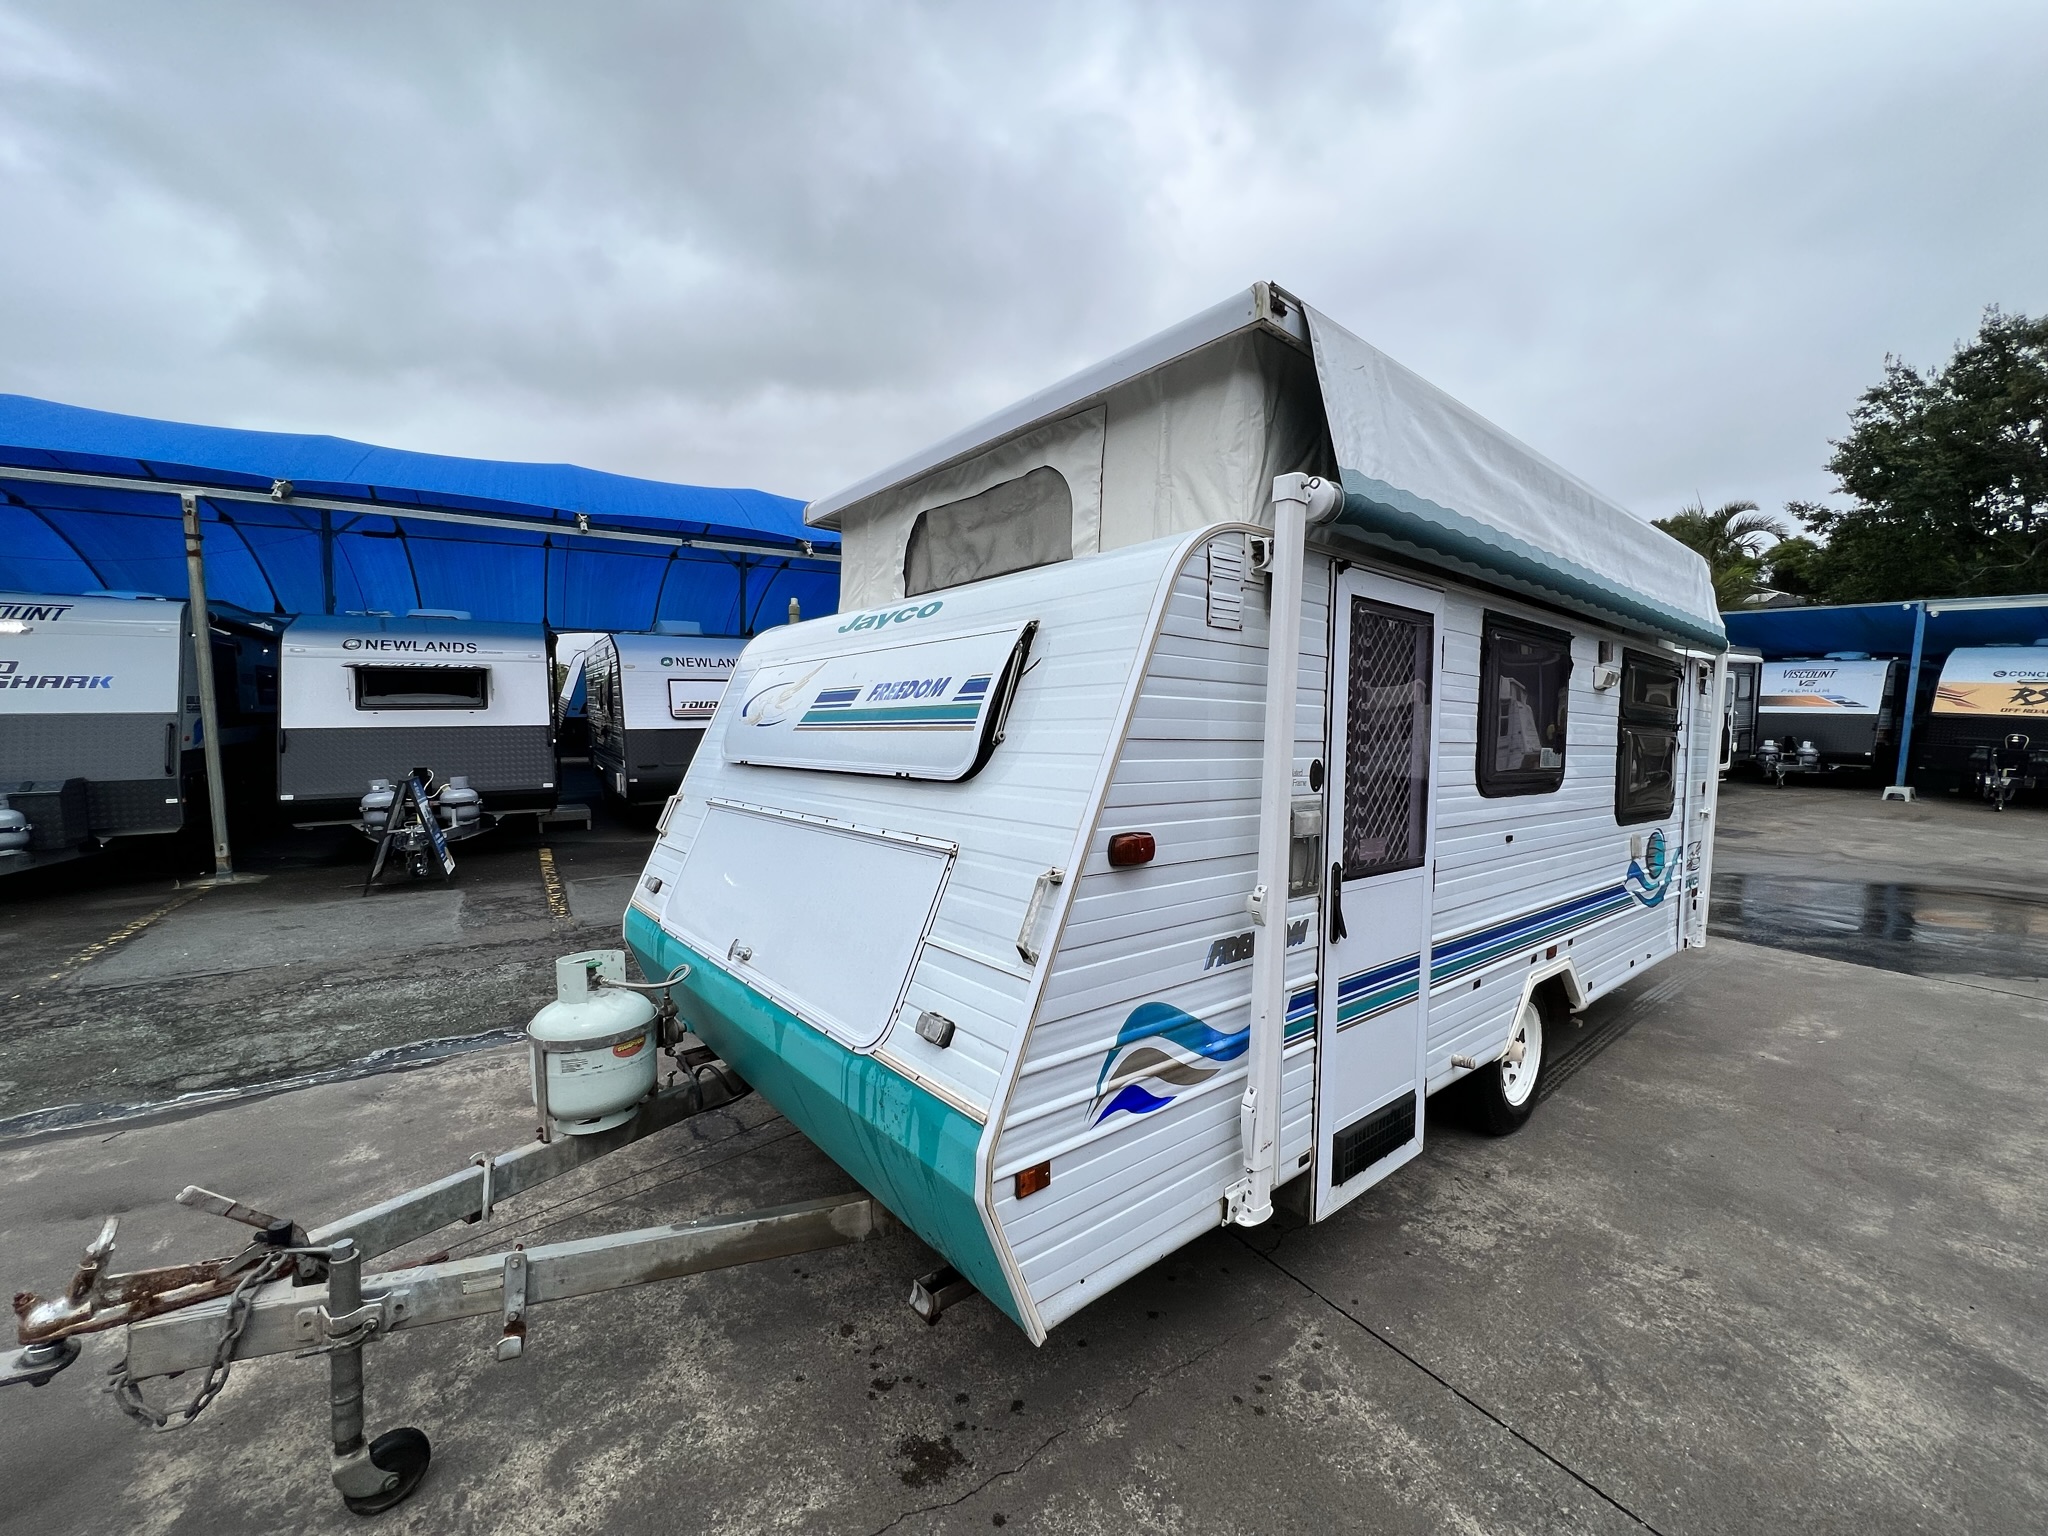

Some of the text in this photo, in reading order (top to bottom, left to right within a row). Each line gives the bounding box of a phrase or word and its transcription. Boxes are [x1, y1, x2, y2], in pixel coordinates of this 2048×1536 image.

[838, 601, 943, 633] Jayco
[365, 639, 477, 654] NEWLANDS
[675, 657, 739, 668] NEWLAN
[1783, 668, 1839, 679] VISCOUNT
[866, 676, 952, 701] FREEDOM
